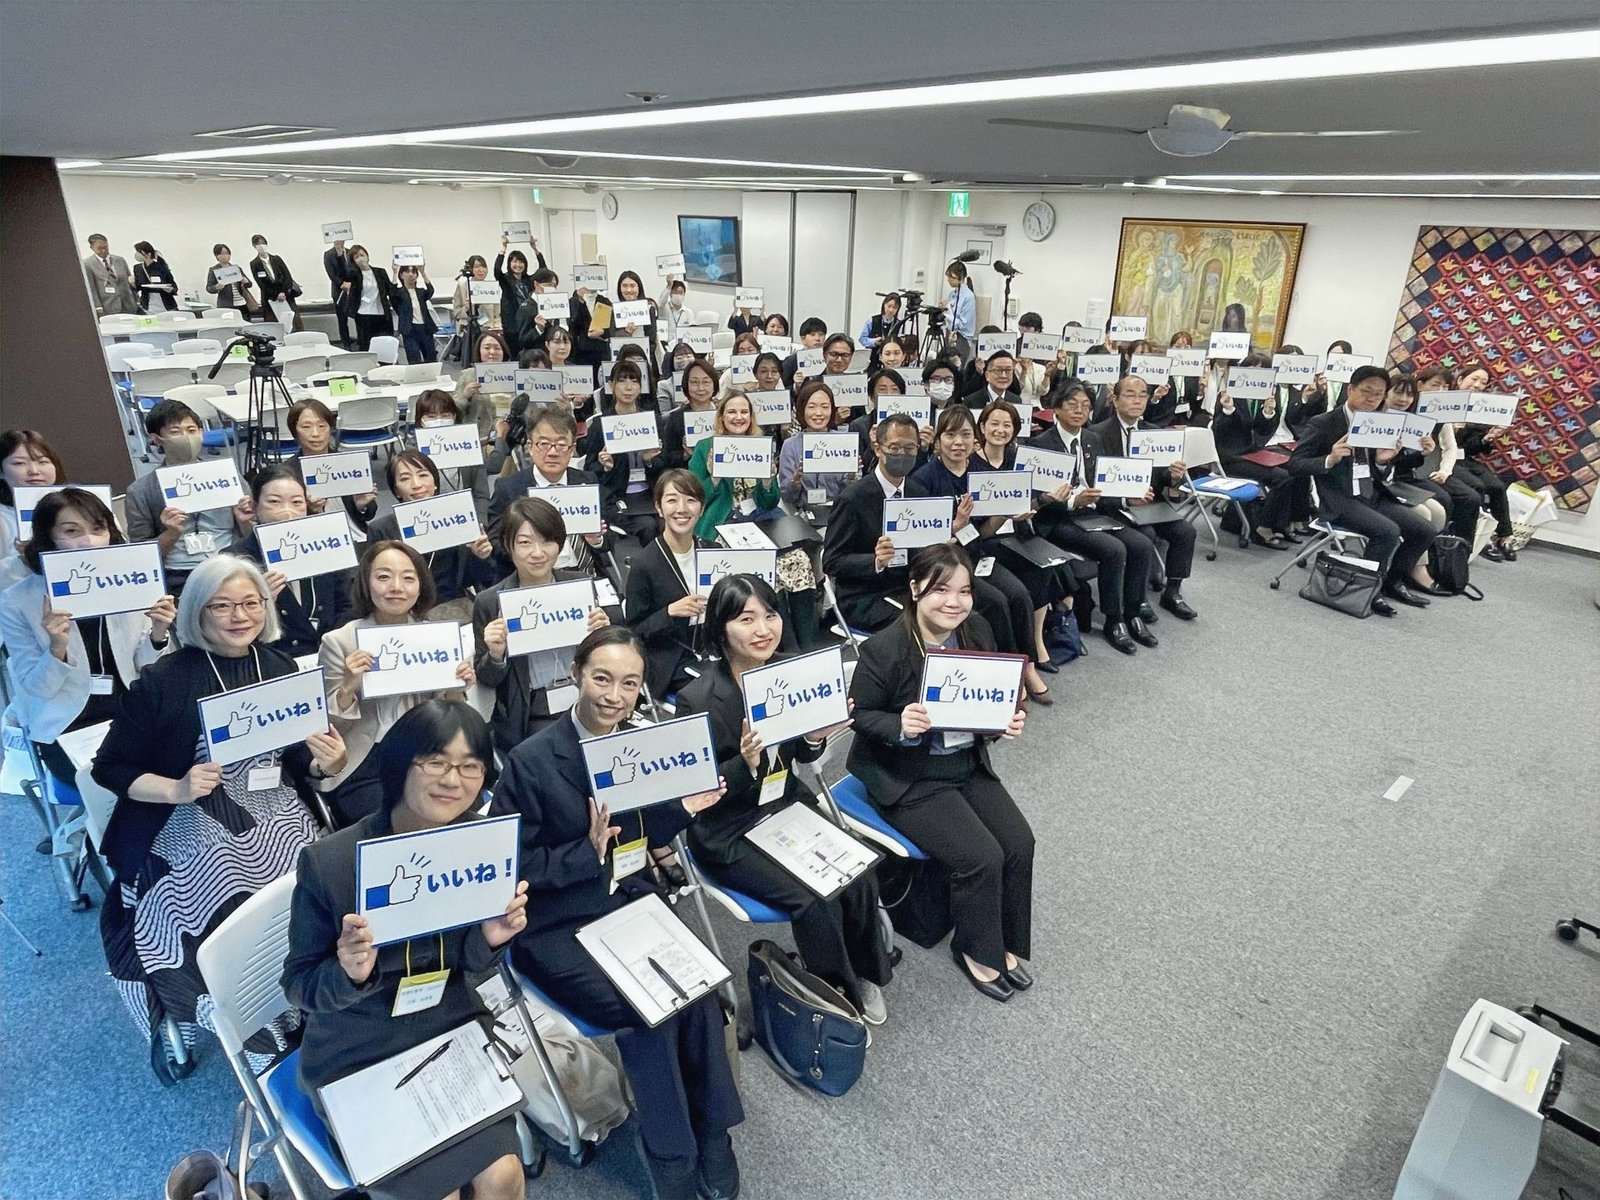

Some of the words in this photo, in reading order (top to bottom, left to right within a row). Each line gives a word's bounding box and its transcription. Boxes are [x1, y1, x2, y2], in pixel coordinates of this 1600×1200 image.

[339, 384, 345, 392] F
[763, 403, 789, 412] いいね！
[625, 426, 656, 437] いいね！
[443, 440, 479, 452] いいね！
[1151, 443, 1181, 453] いいね！
[736, 453, 769, 463] いいね！
[825, 448, 857, 459] いいね！
[331, 468, 370, 480] いいね！
[1037, 466, 1071, 480] いいね！
[1118, 474, 1149, 483] いいね！
[194, 476, 239, 492] いいね！
[993, 488, 1029, 499] いいね！
[559, 504, 598, 516] いいね！
[431, 511, 475, 530] いいね！
[912, 518, 951, 530] いいね！
[300, 533, 350, 554] いいね！
[96, 569, 160, 589] いいね！
[403, 648, 460, 665] いいね！
[788, 678, 842, 707] いいね！
[962, 687, 1015, 703] いいね！
[256, 697, 323, 727] いいね！
[640, 747, 710, 775] いいね！
[427, 858, 512, 892] いいね！
